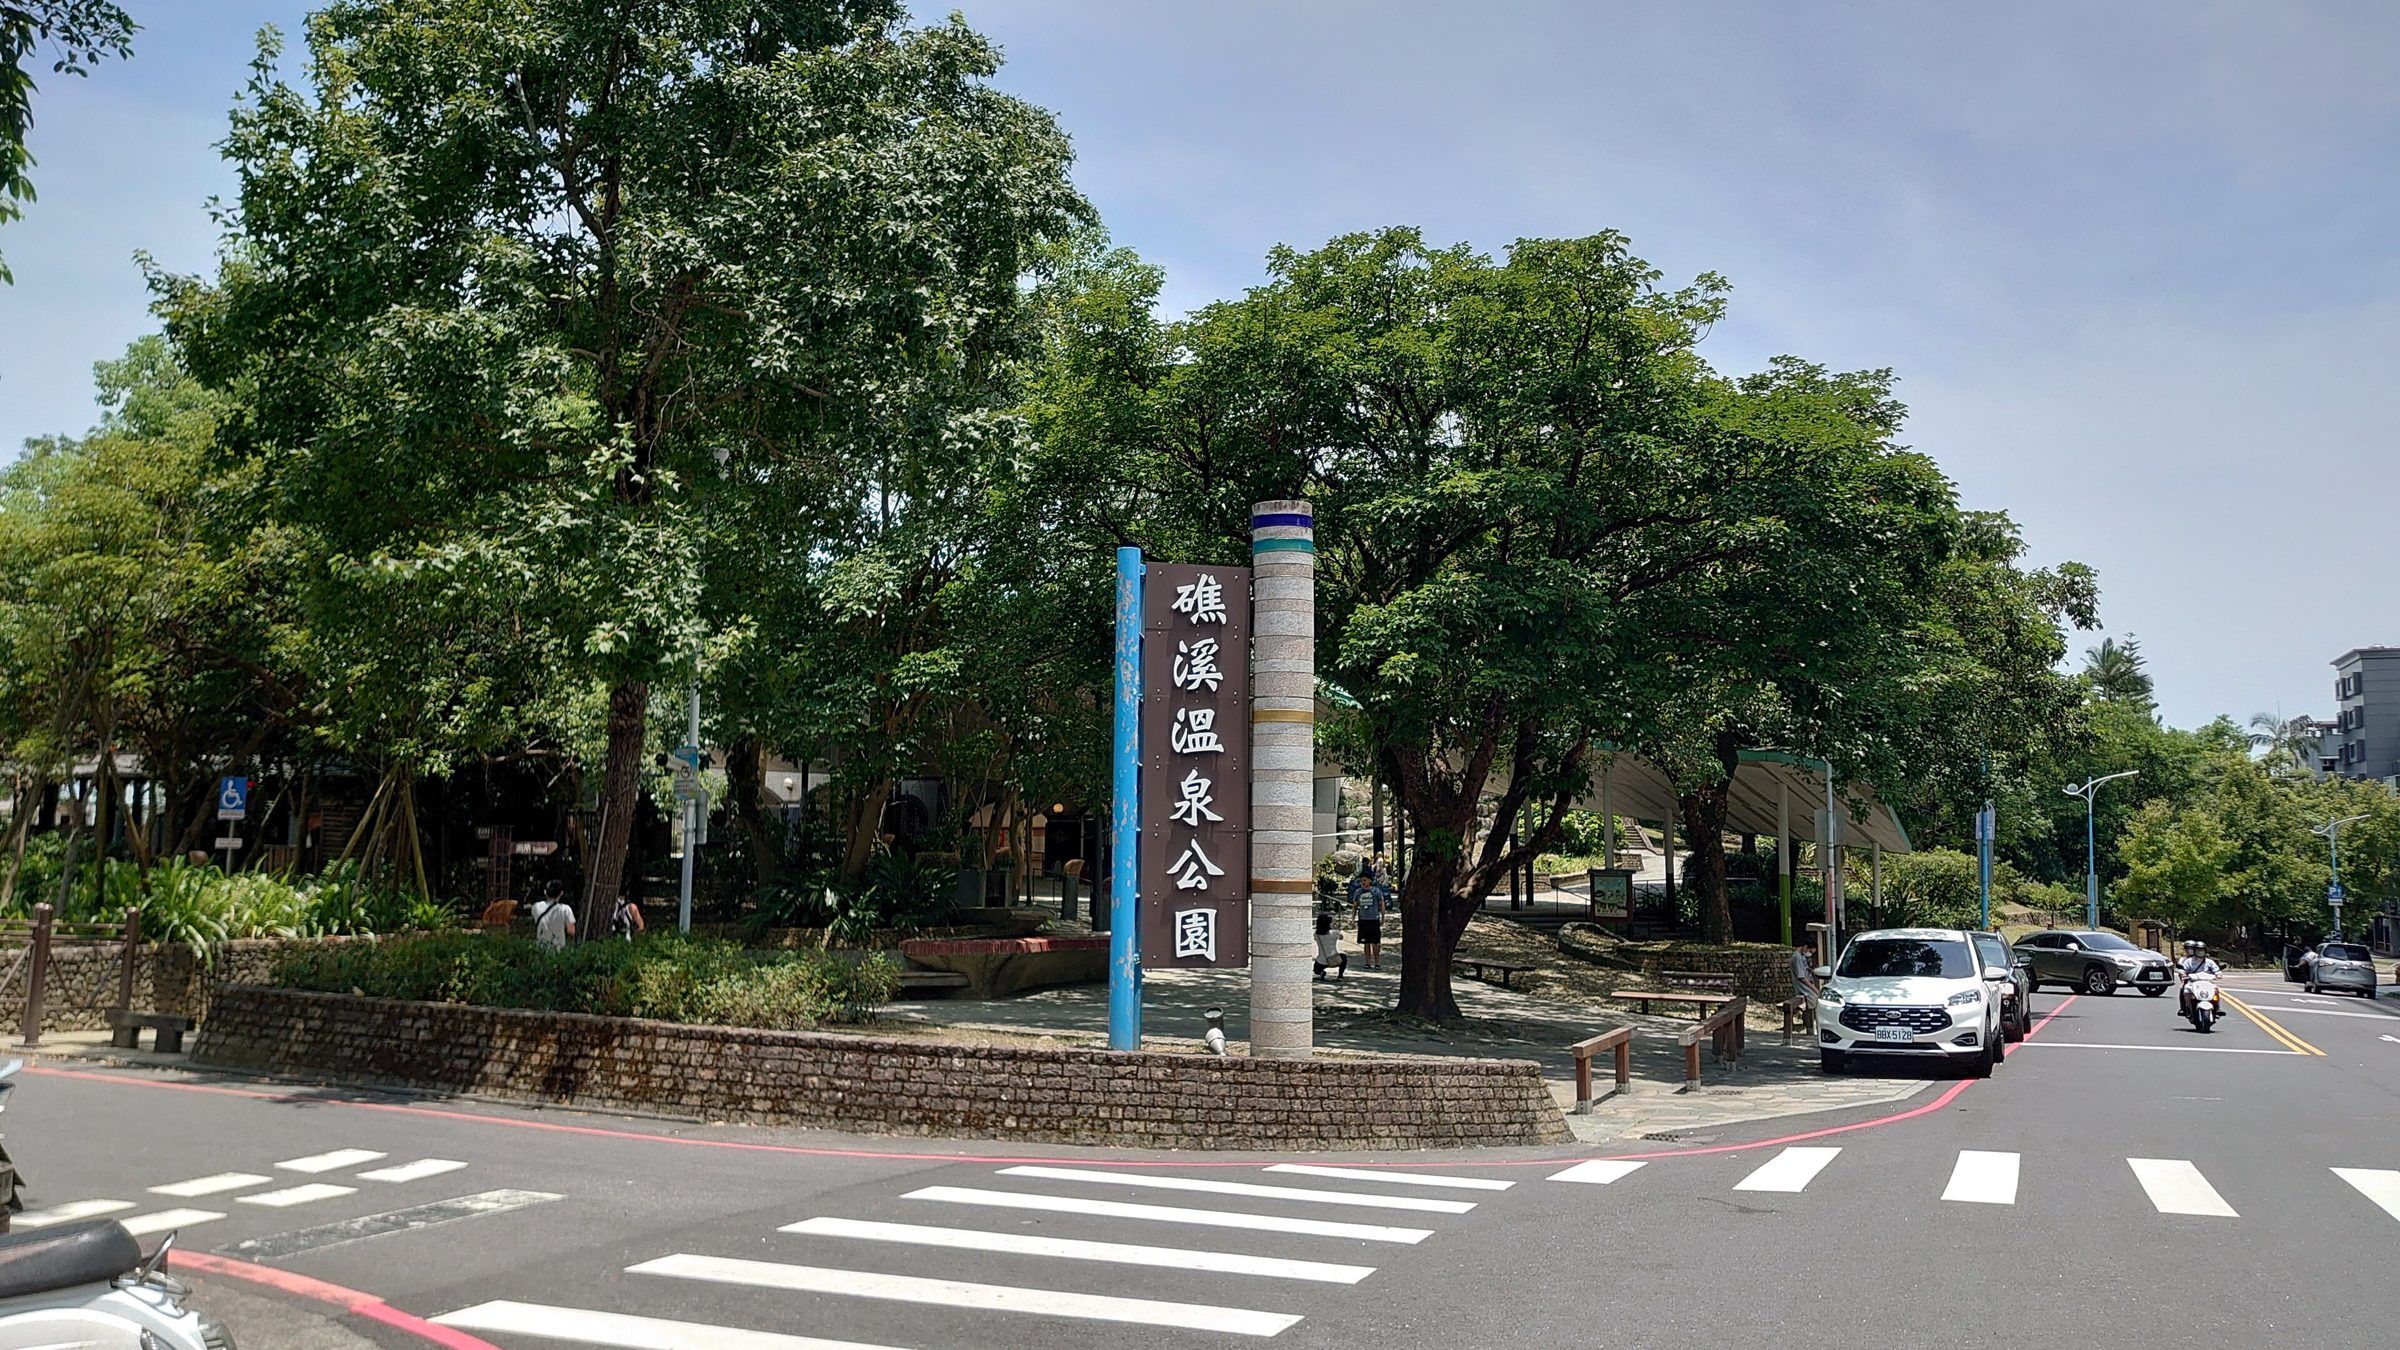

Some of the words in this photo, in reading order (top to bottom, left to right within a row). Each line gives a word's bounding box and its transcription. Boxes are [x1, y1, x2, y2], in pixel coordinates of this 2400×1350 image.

[1166, 573, 1227, 962] 礁溪溫泉公園
[1876, 1029, 1912, 1040] BBX-5128
